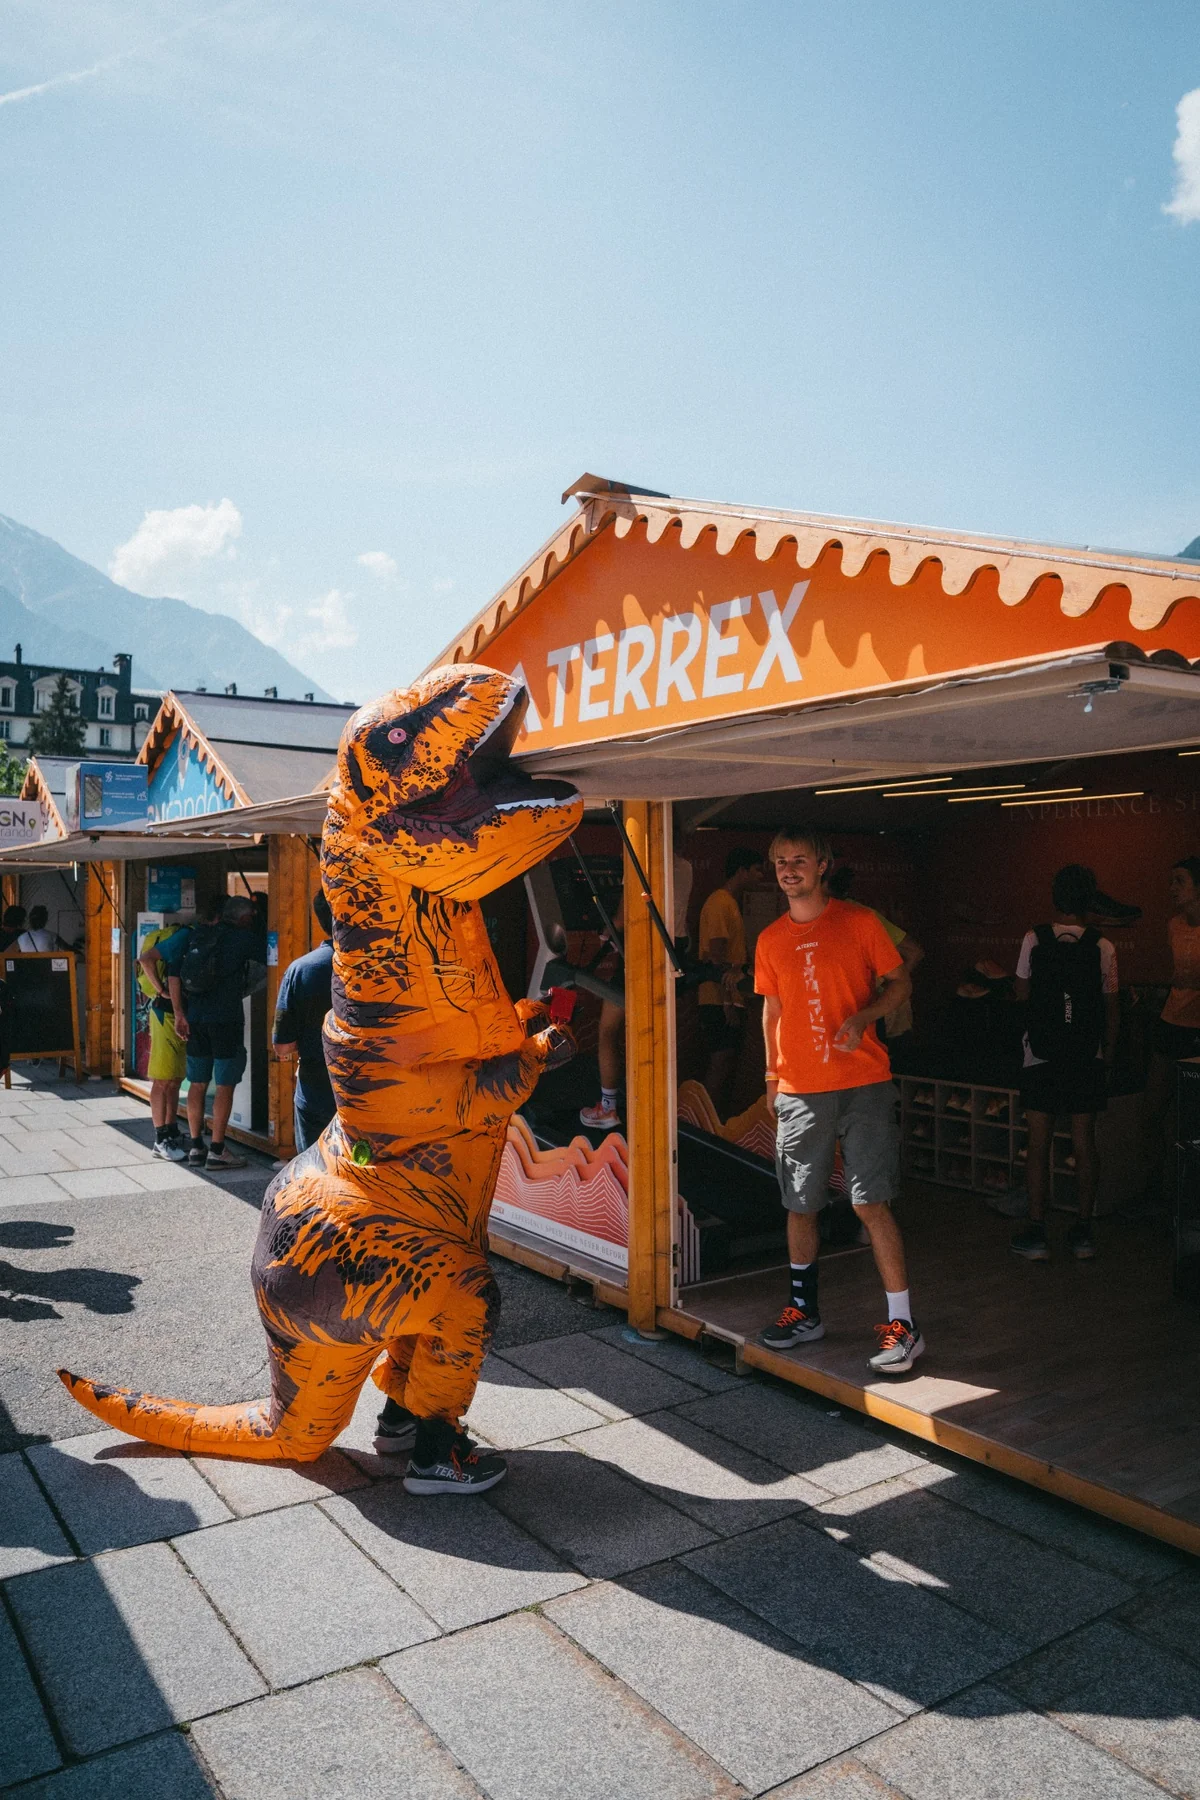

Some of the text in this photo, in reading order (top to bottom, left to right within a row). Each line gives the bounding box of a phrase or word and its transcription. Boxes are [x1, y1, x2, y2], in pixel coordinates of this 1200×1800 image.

[545, 1223, 563, 1238] SPEED
[564, 1231, 578, 1244] LIKE
[579, 1238, 600, 1252] NEVER
[601, 1245, 627, 1262] BEFORE
